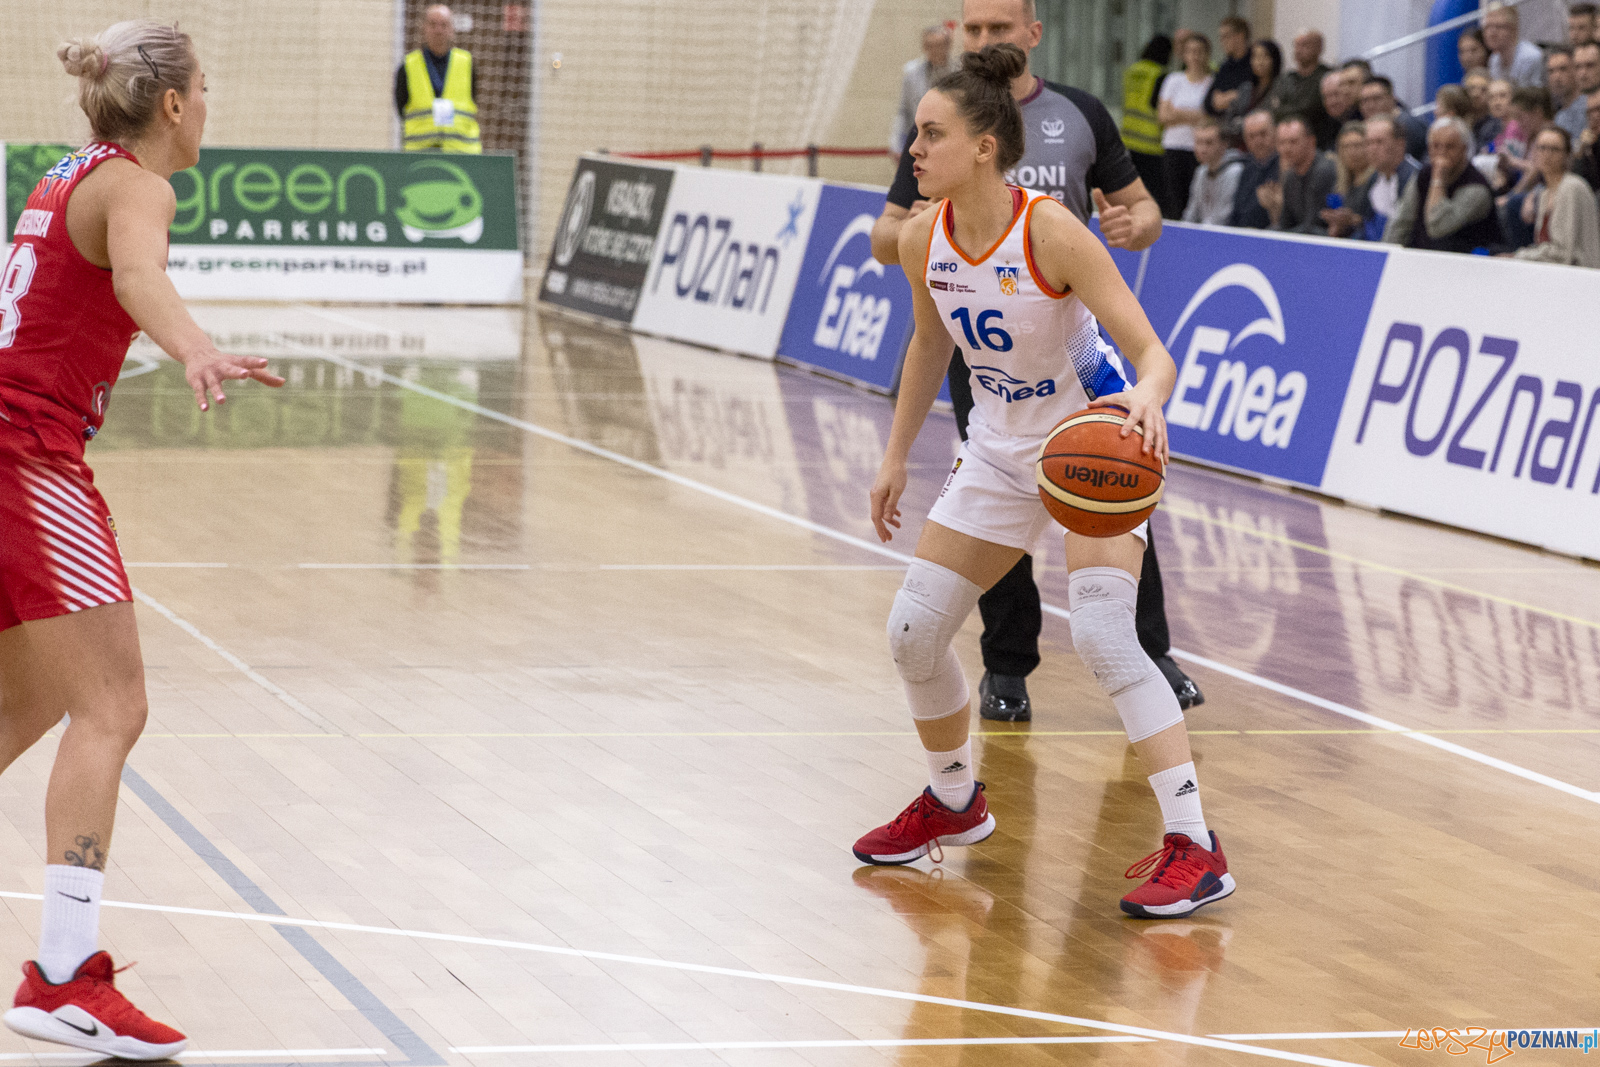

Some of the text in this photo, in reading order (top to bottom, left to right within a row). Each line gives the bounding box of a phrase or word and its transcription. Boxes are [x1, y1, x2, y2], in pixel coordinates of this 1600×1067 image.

[209, 218, 388, 242] PARKING
[814, 265, 891, 360] Enea
[950, 307, 1014, 352] 16
[975, 374, 1056, 403] Enea
[1165, 325, 1307, 449] Enea
[1065, 464, 1139, 488] molten
